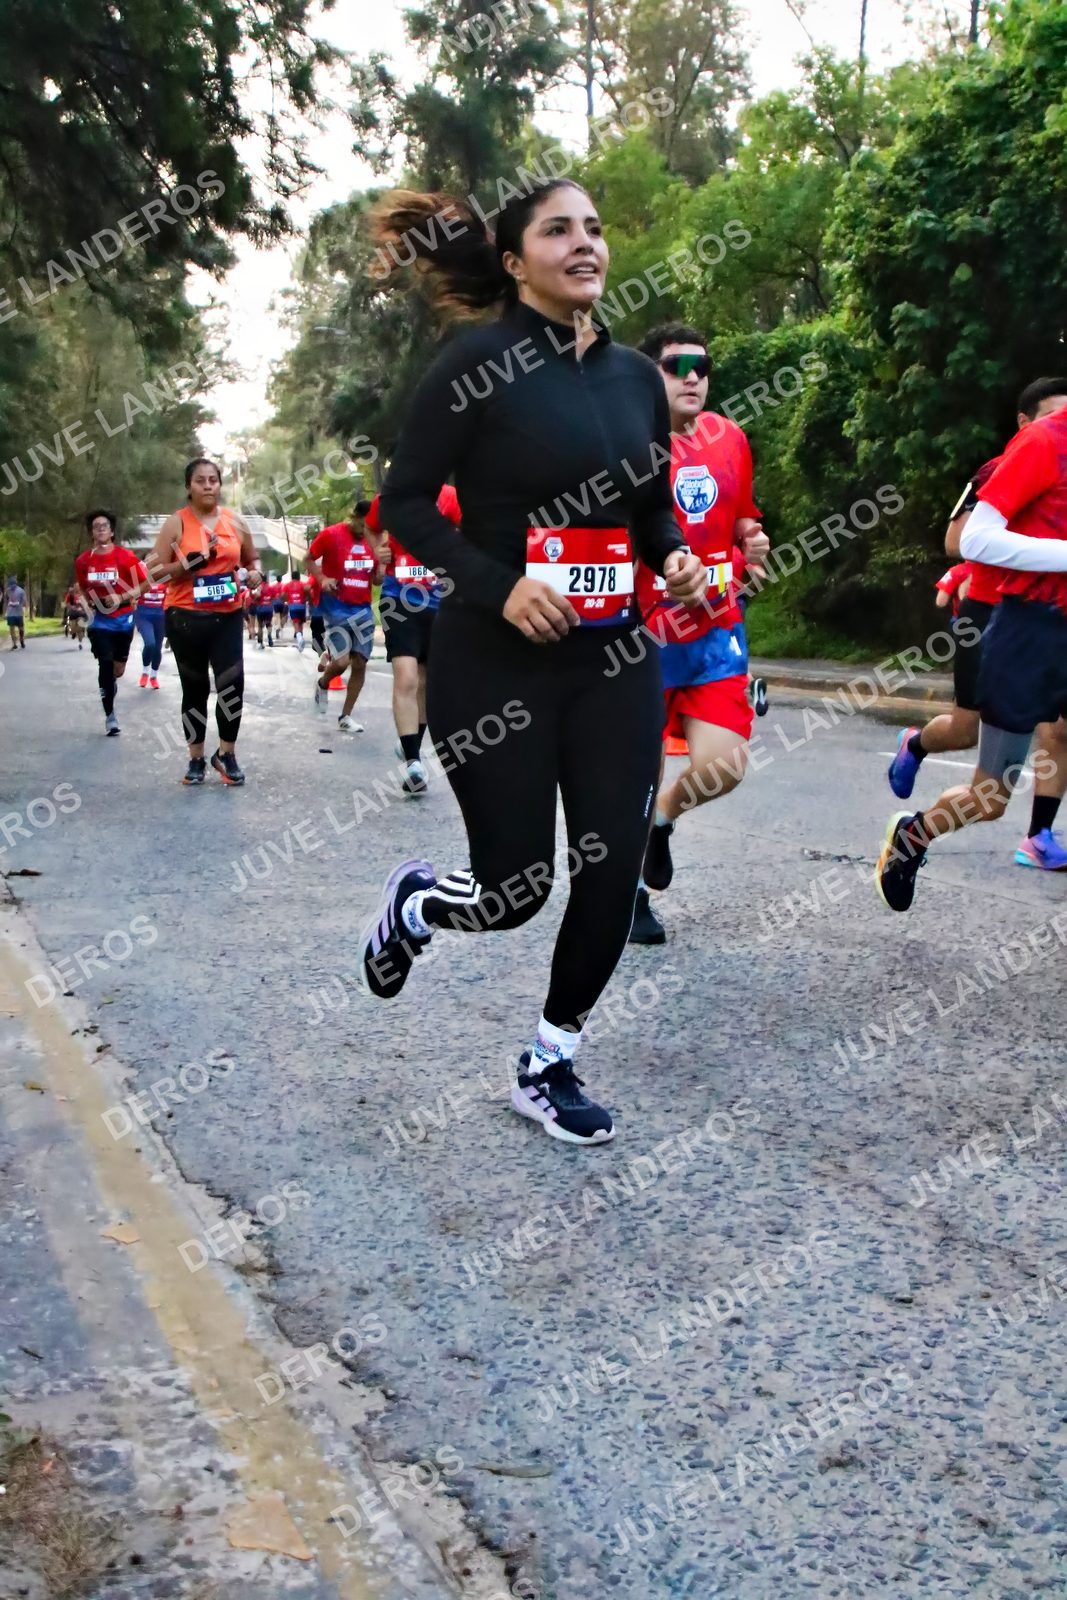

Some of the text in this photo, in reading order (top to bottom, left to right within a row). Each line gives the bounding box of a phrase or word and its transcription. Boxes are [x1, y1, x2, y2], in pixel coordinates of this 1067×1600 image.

[408, 566, 428, 576] 1868
[569, 566, 616, 593] 2978
[207, 585, 225, 596] 5169
